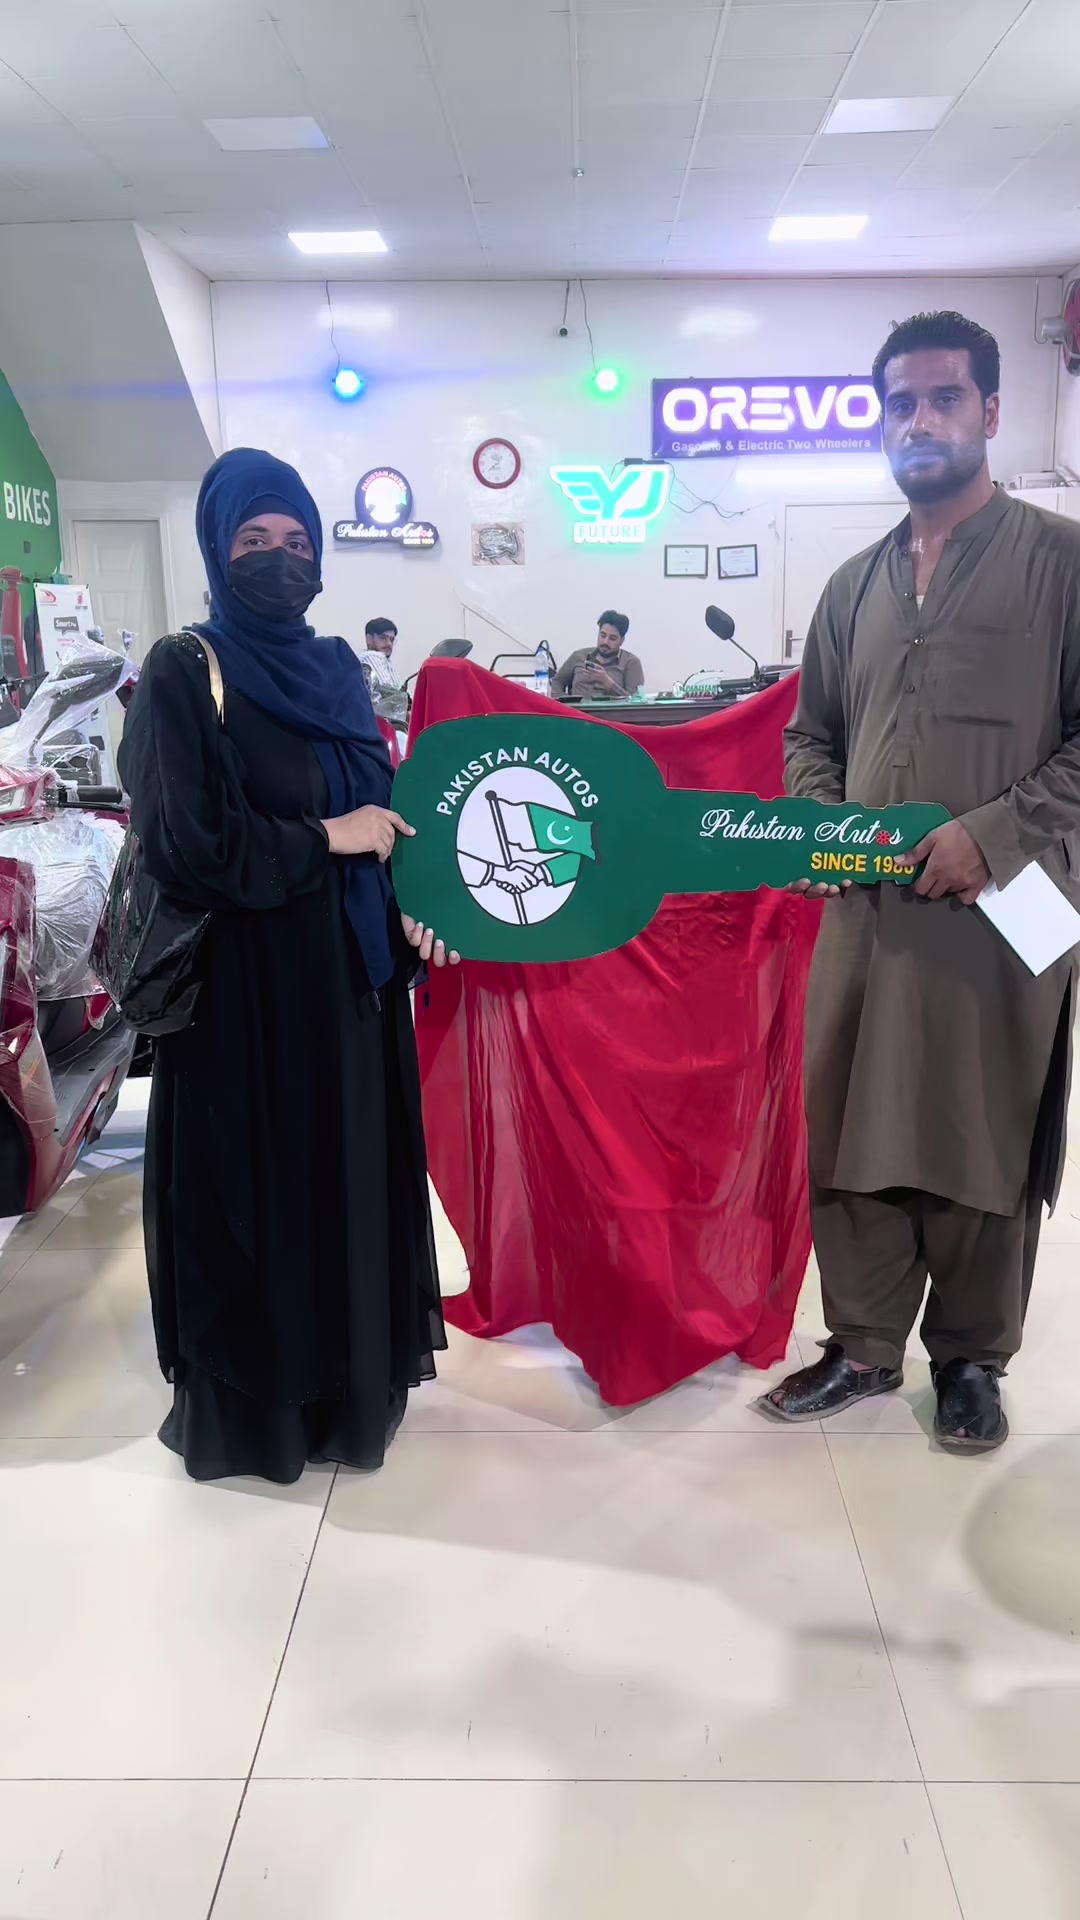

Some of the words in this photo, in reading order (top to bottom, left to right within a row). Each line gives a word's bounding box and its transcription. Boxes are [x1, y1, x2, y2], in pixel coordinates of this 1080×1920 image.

[662, 384, 882, 433] OREVO
[671, 439, 721, 453] Gasoline
[725, 440, 734, 451] &
[738, 439, 784, 451] Electric
[787, 439, 811, 450] Two
[815, 438, 871, 449] Wheelers
[3, 481, 52, 527] BIKES
[336, 523, 388, 538] Pakistan
[577, 524, 642, 539] FUTURE
[436, 746, 529, 816] PAKISTAN
[534, 751, 599, 808] AUTOS
[699, 808, 805, 840] Pakistan
[810, 852, 867, 872] SINCE
